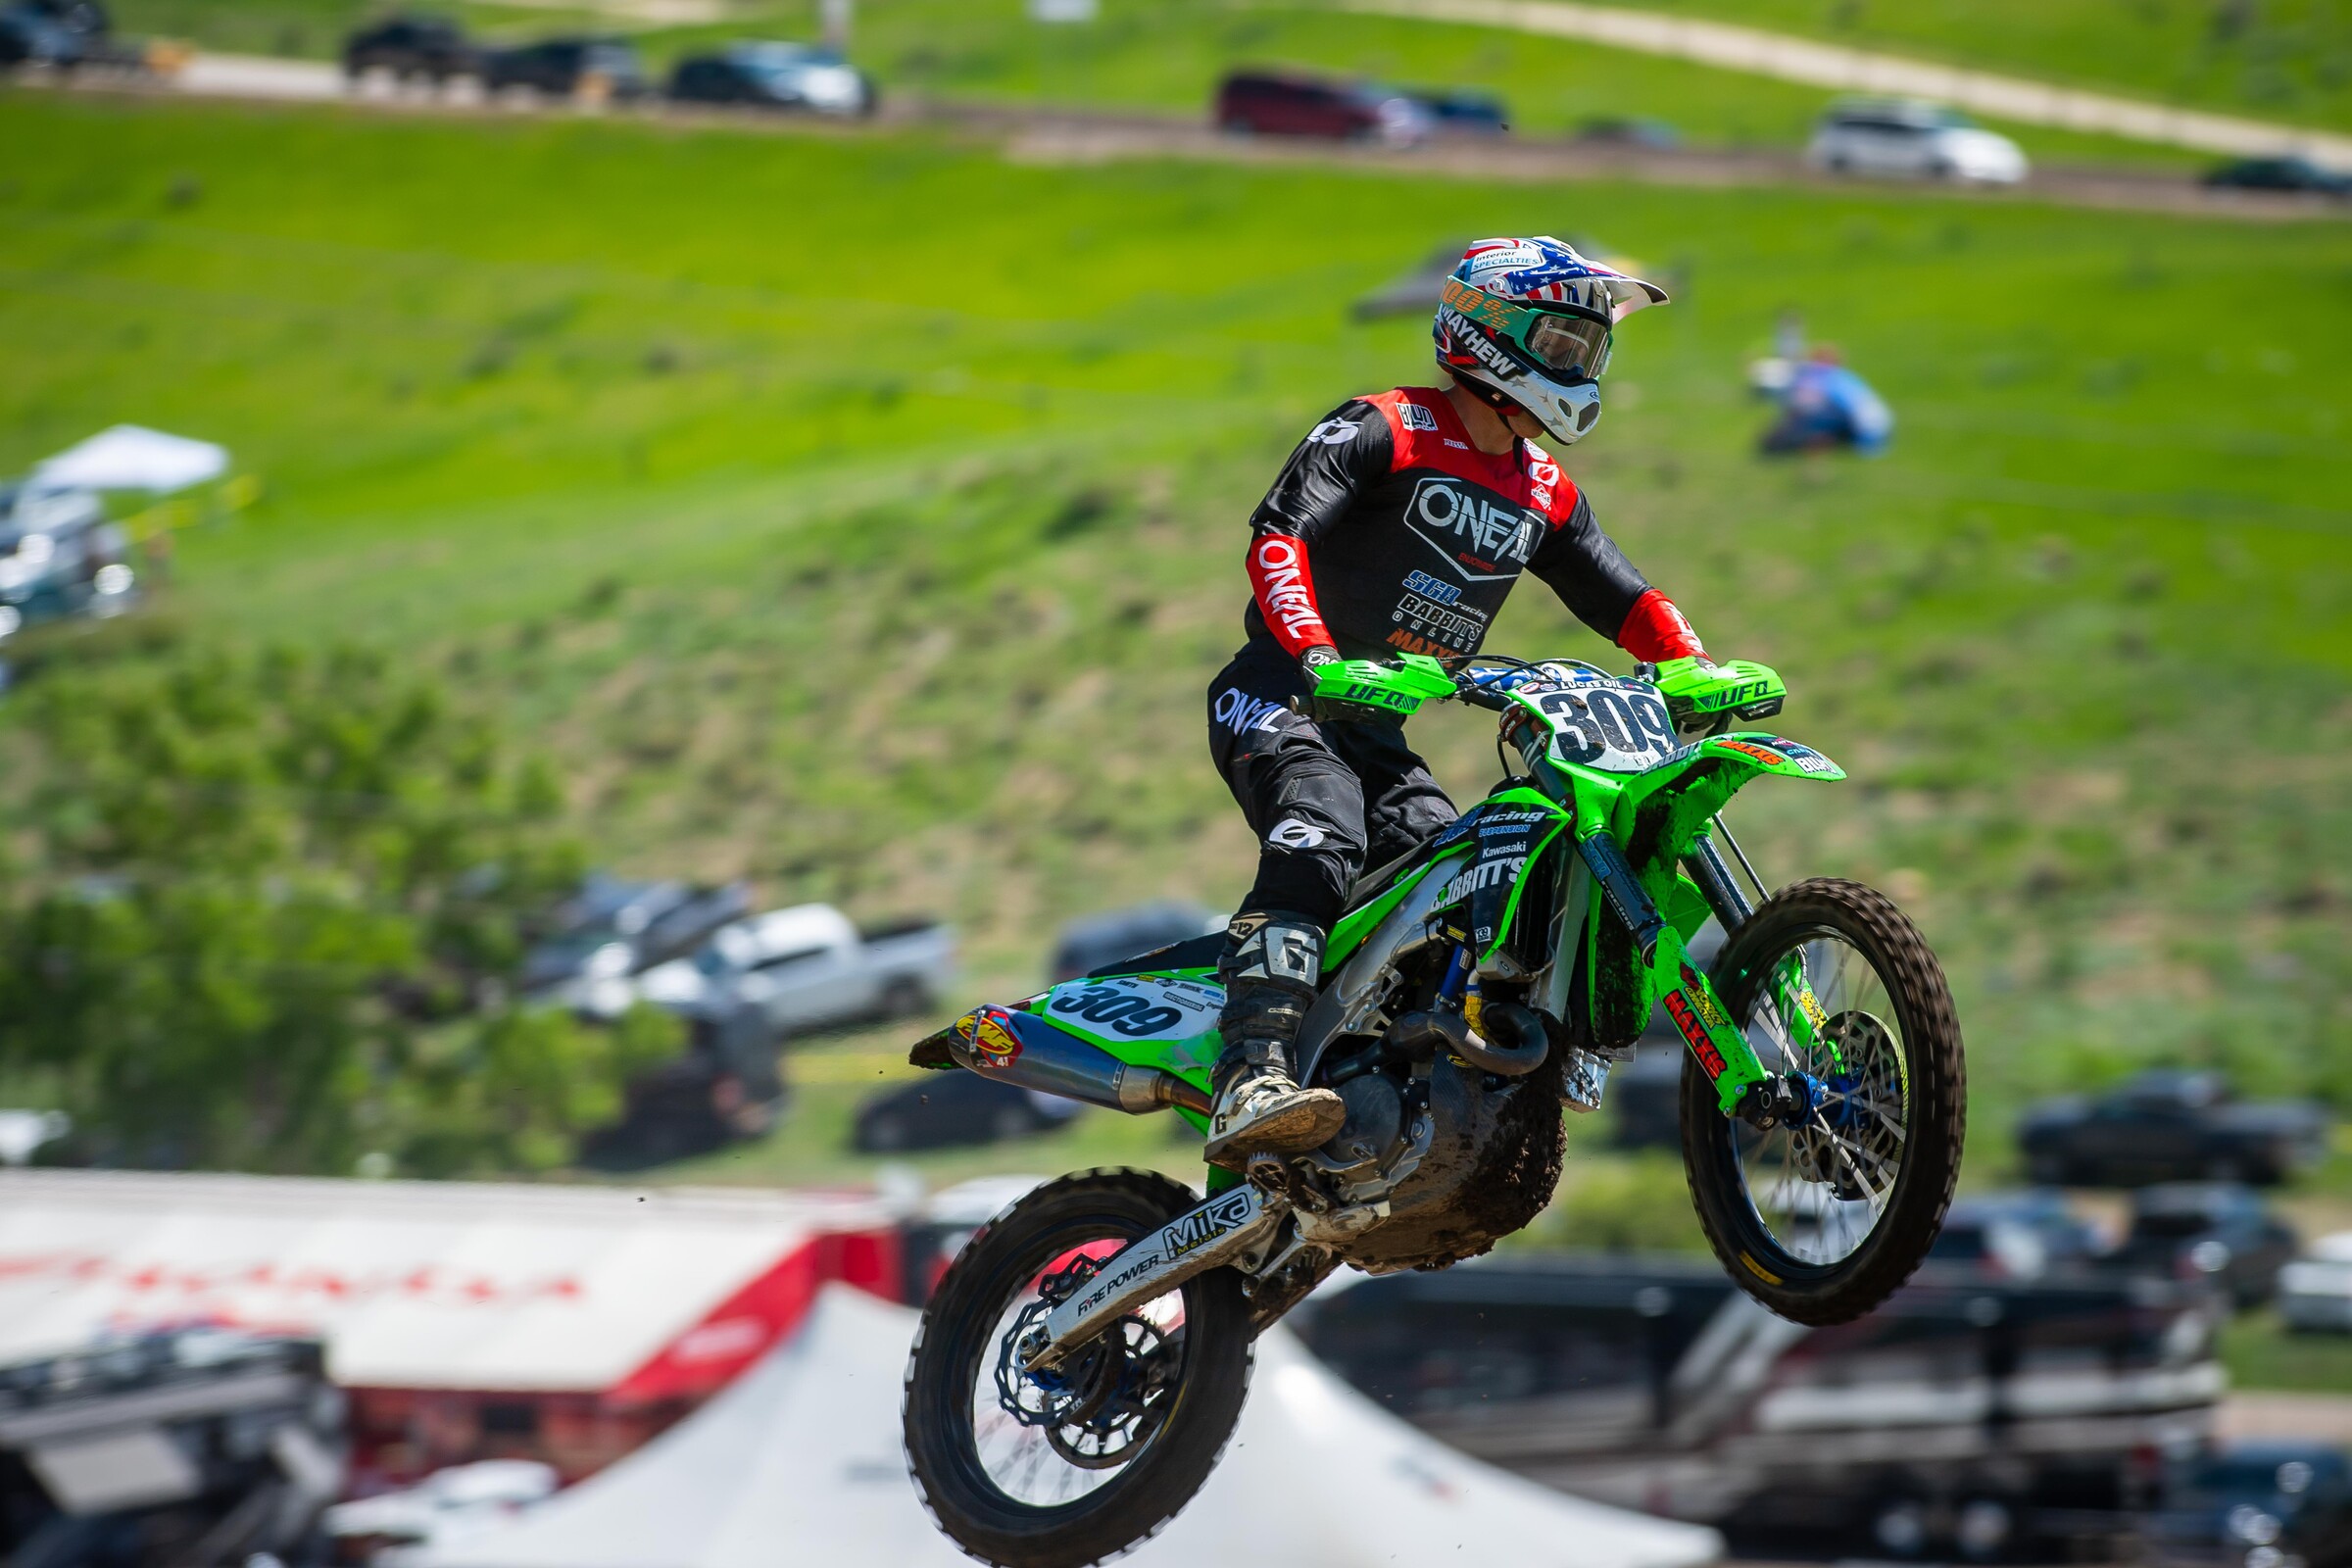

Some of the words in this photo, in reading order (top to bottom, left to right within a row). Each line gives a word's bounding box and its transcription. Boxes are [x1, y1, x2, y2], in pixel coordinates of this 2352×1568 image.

[1473, 257, 1540, 270] SPECIALTIES
[1441, 278, 1517, 329] 00%
[1442, 306, 1517, 375] MAYHEW
[1392, 611, 1474, 653] ONLINE
[1345, 684, 1401, 707] UFO
[1560, 680, 1601, 690] LUCAS
[1603, 679, 1624, 690] OIL
[1719, 680, 1768, 707] UFO
[1540, 690, 1684, 763] 309
[1717, 740, 1786, 765] MAXXIS
[1471, 810, 1545, 827] racing
[1479, 824, 1531, 837] SUSPENSION
[1482, 841, 1526, 858] Kawasaki
[1052, 985, 1182, 1037] 309
[1664, 990, 1727, 1079] MAXXIS
[1177, 1227, 1226, 1254] Metals
